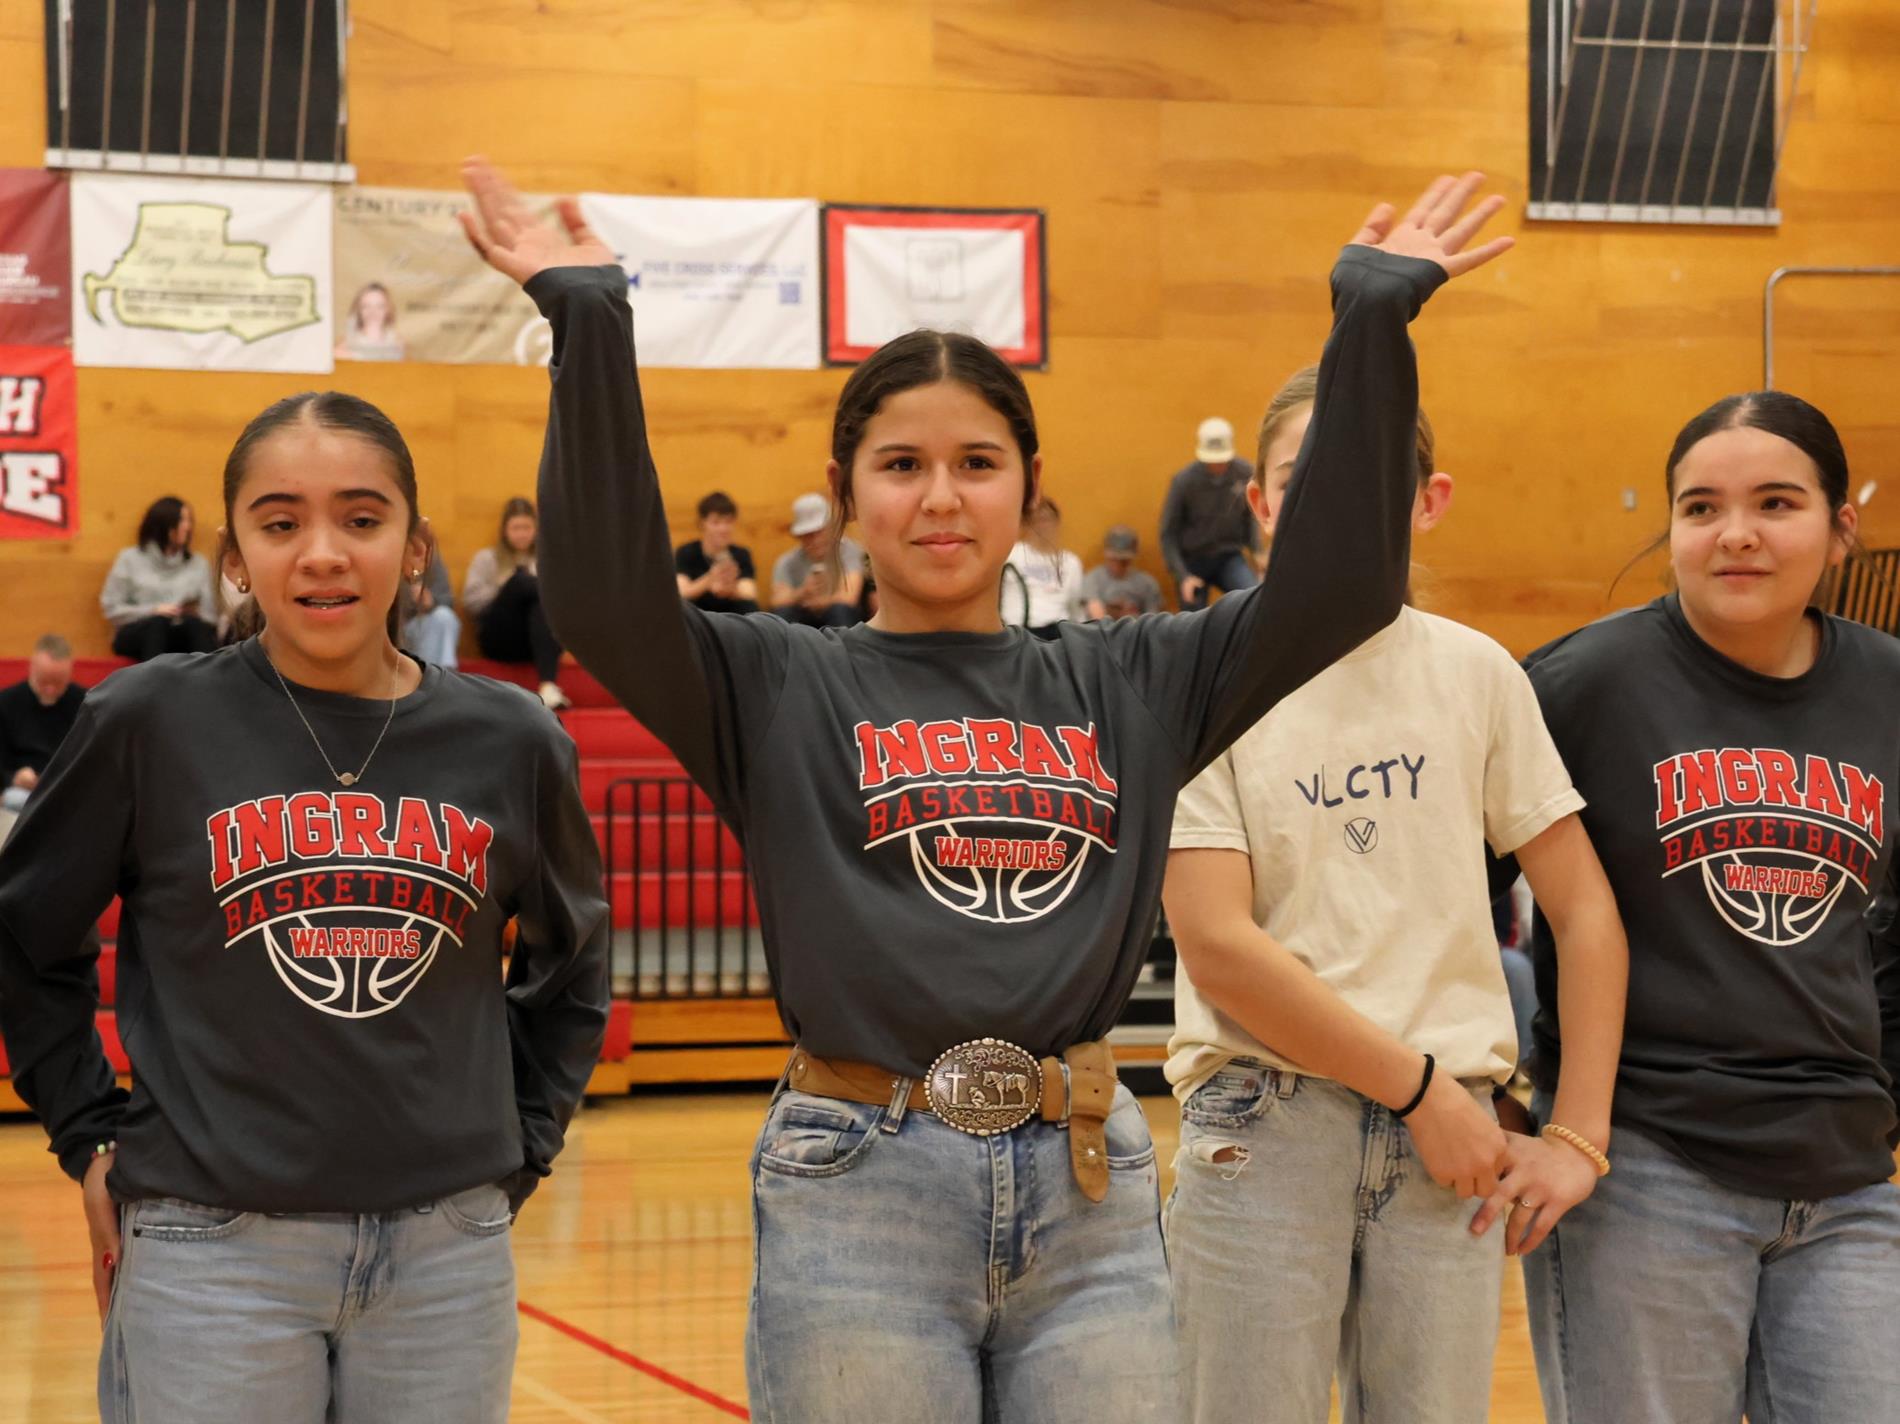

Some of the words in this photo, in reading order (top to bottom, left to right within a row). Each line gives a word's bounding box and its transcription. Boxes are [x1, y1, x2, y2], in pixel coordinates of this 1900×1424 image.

[0, 451, 69, 527] E
[854, 717, 1118, 798] INGRAM
[1294, 753, 1425, 808] VLCTY
[867, 785, 1116, 845] BASKETBALL
[1653, 748, 1883, 848] INGRAM
[207, 791, 494, 899] INGRAM
[935, 836, 1066, 870] WARRIORS
[1663, 818, 1871, 885] BASKETBALL
[223, 872, 473, 939] BASKETBALL
[1724, 864, 1828, 898] WARRIORS
[288, 927, 421, 958] WARRIORS
